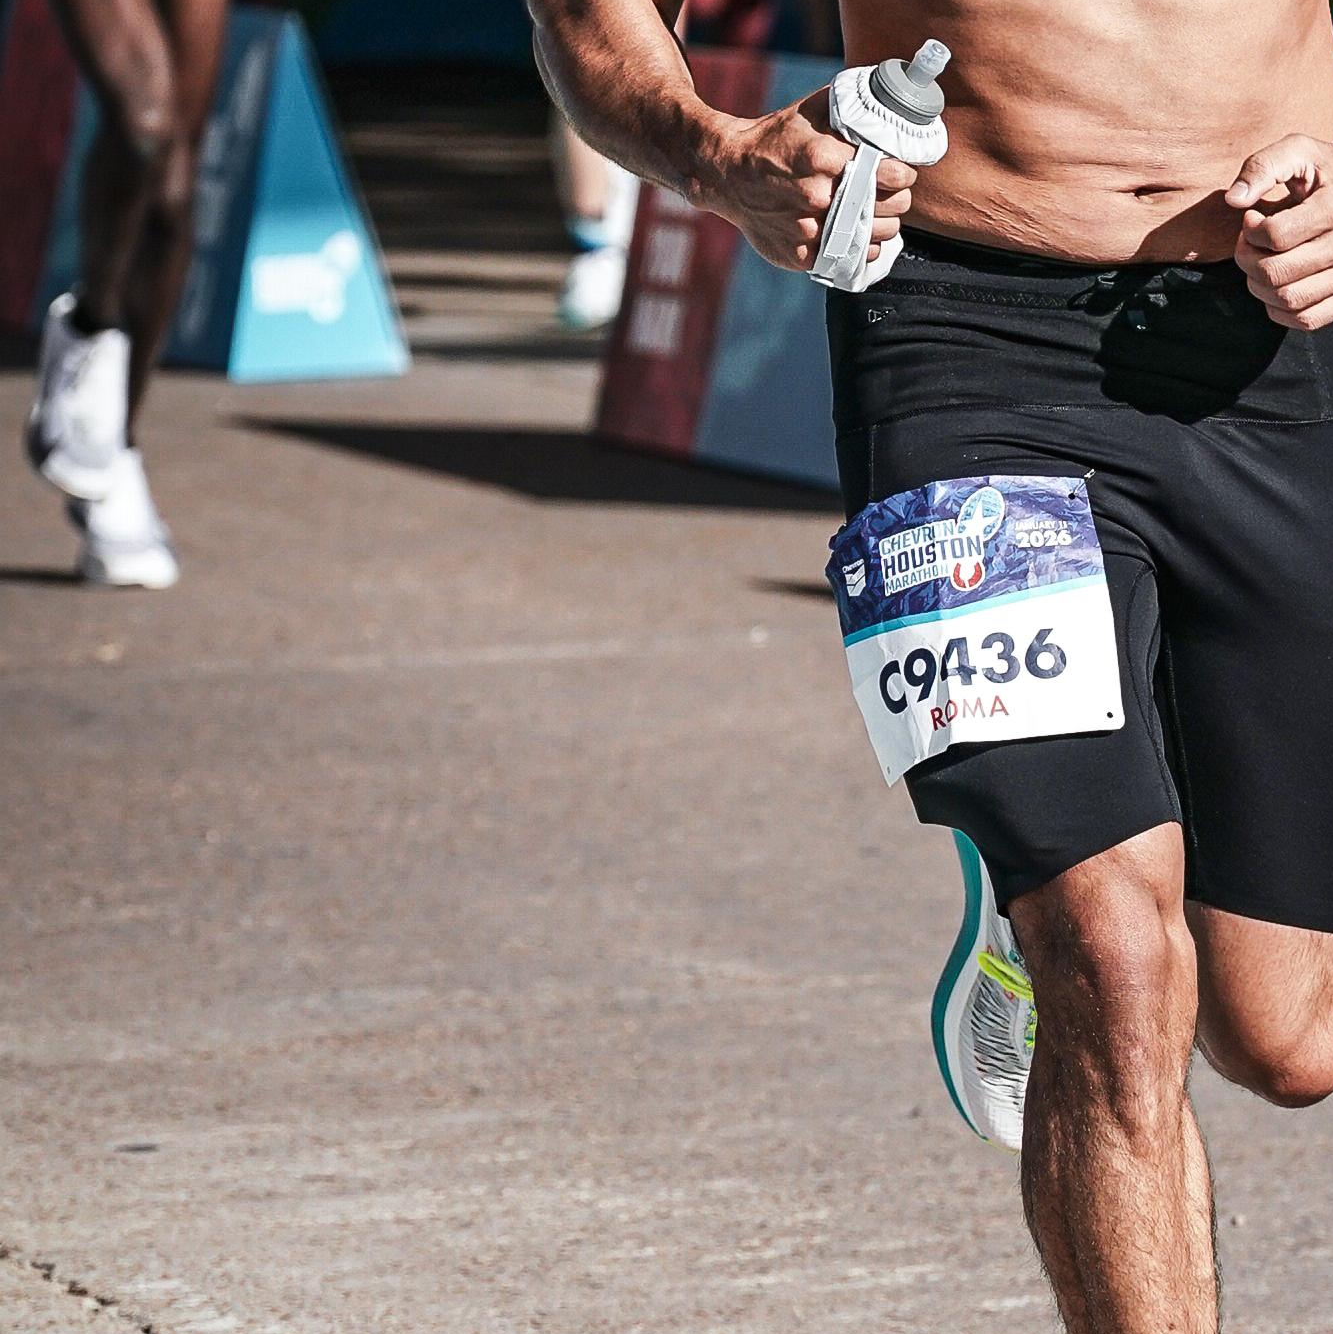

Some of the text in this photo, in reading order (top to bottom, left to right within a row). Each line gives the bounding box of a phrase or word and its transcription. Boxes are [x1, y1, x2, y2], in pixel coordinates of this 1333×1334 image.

[881, 521, 954, 556] CHEVRON
[1015, 529, 1072, 548] 2026
[883, 535, 982, 580] HOUSTON
[886, 563, 949, 595] MARATHON
[879, 628, 1067, 714] C9436
[930, 695, 1009, 731] ROMA
